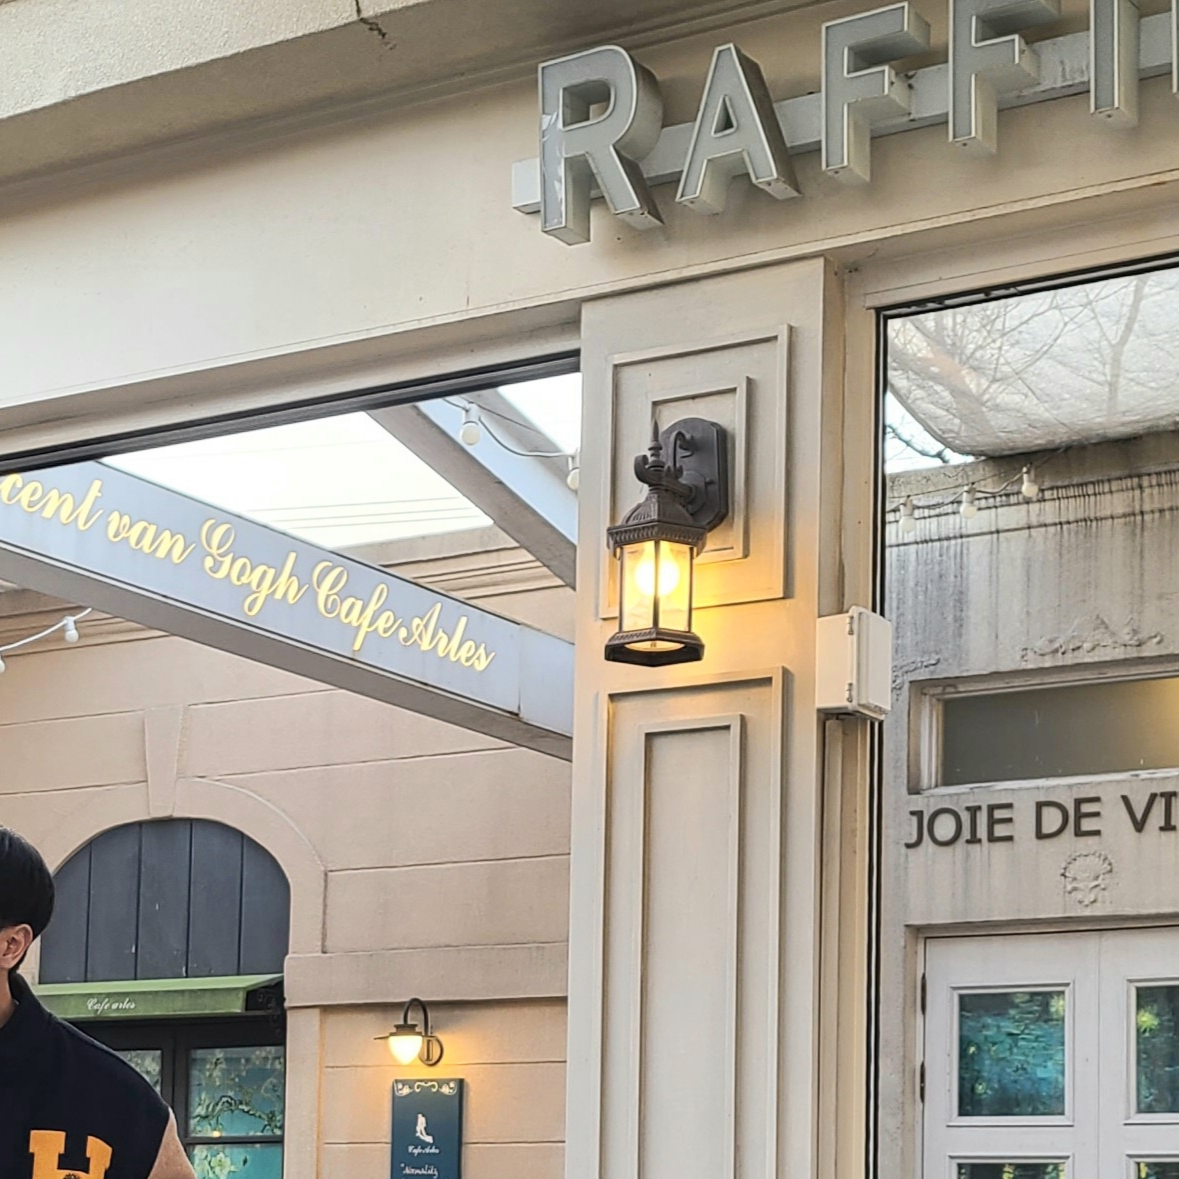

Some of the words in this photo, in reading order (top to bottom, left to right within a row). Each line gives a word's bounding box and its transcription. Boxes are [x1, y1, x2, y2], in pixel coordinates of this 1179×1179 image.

[538, 0, 1179, 240] RAFFI
[106, 510, 196, 564] van
[199, 517, 309, 617] Gogh
[311, 560, 403, 652] Cafe
[398, 601, 496, 672] Arles
[904, 802, 1014, 849] JOIE
[1034, 795, 1102, 840] DE
[1120, 789, 1179, 834] VI
[87, 997, 111, 1015] Cafe
